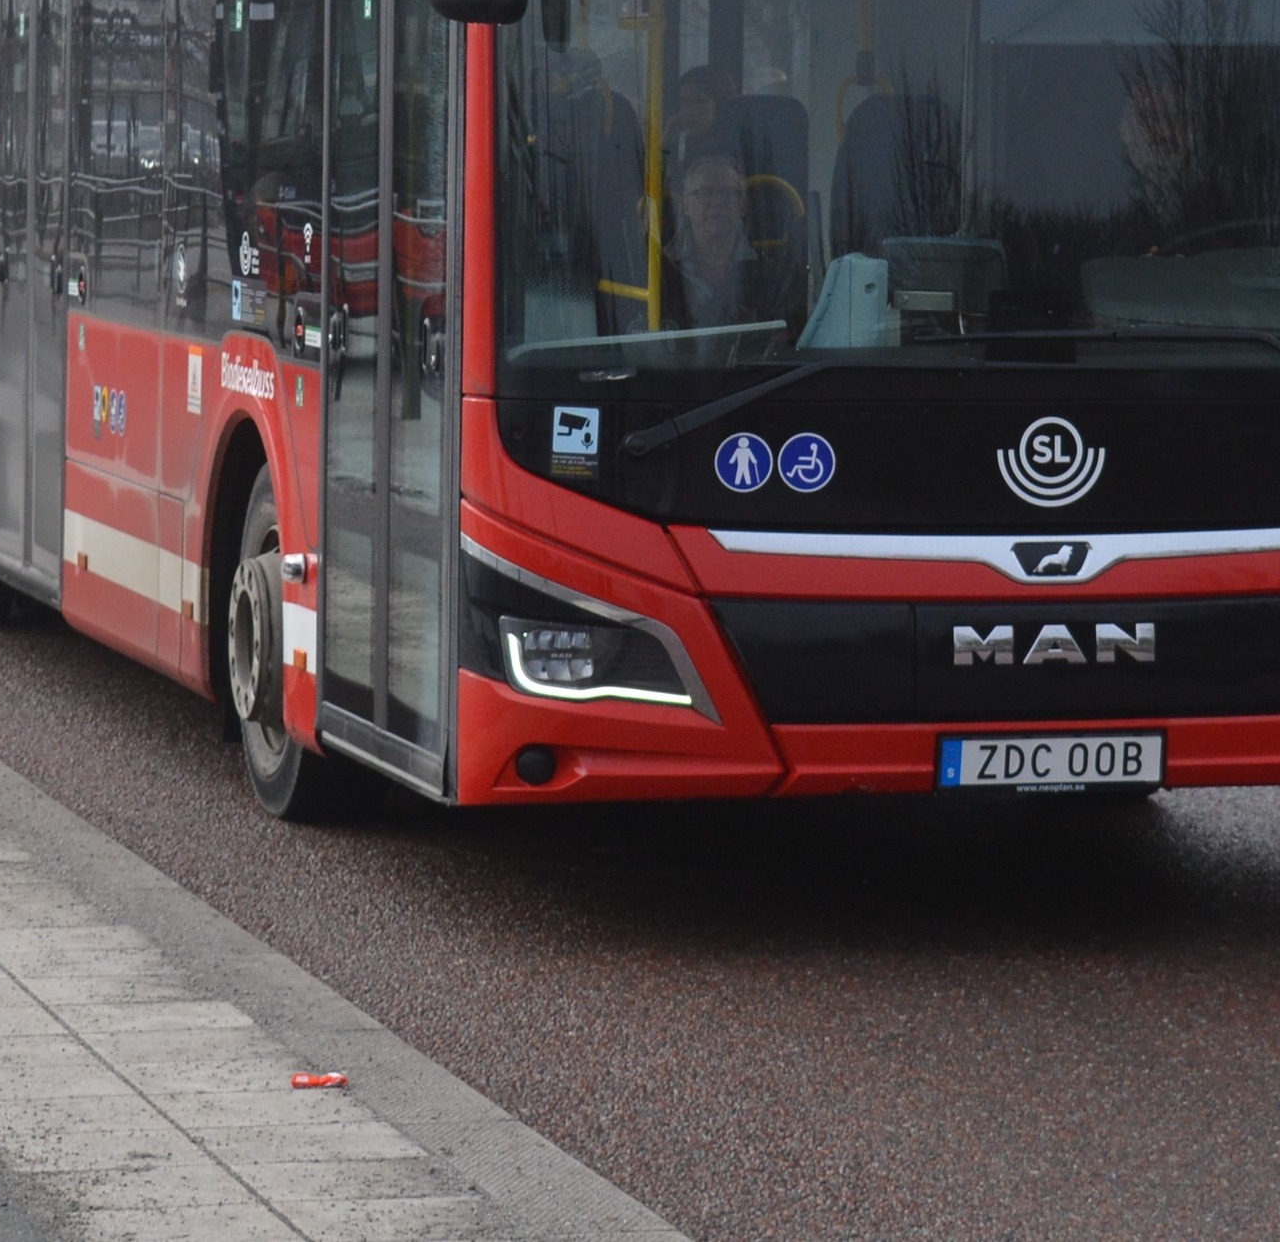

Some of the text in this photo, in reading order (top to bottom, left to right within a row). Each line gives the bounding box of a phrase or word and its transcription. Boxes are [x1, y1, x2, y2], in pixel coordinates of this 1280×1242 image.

[221, 351, 275, 400] Biodieselbuss
[1032, 434, 1071, 463] SL
[953, 623, 1156, 665] MAN
[977, 743, 1052, 780] ZDC
[1016, 783, 1086, 793] www.neoplan.se
